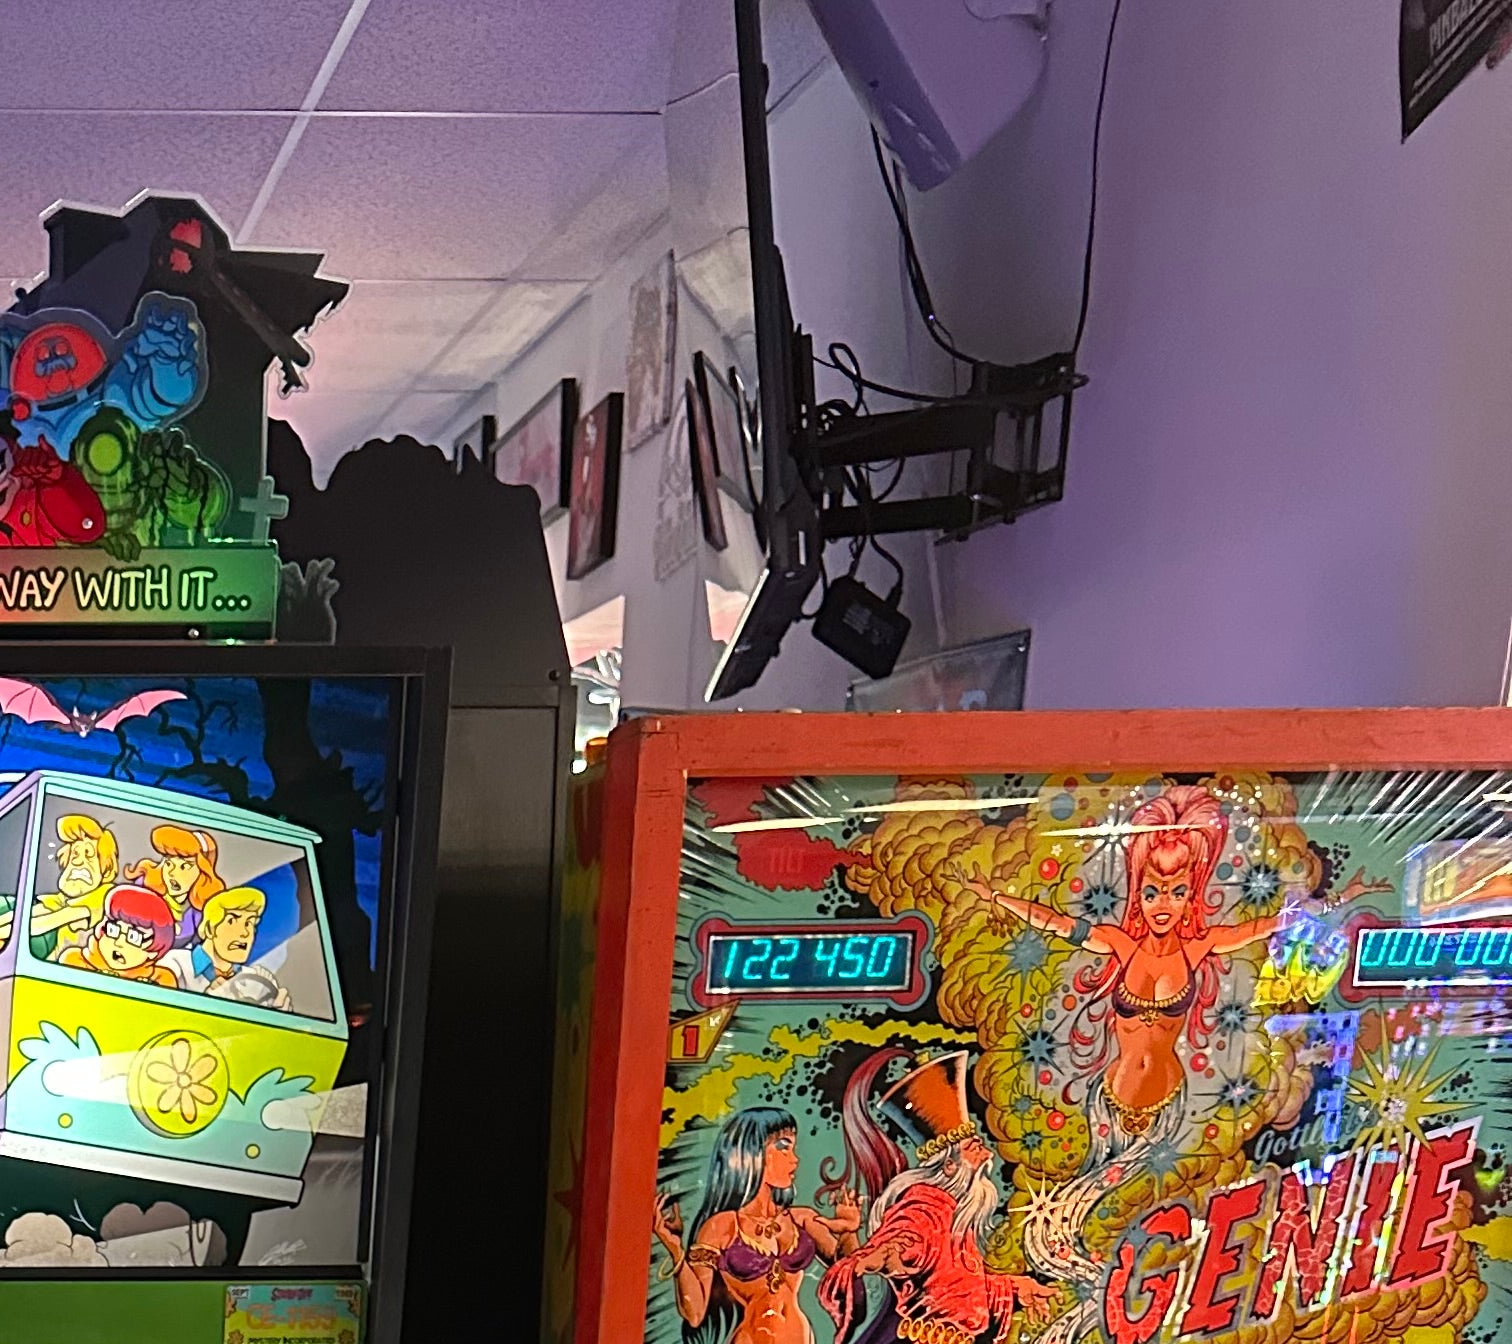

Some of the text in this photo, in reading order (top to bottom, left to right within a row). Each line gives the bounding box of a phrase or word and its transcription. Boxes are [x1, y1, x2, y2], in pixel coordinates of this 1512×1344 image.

[72, 568, 171, 609] WITH
[178, 568, 250, 610] IT...
[724, 936, 897, 980] 122 450
[682, 1026, 699, 1057] 1
